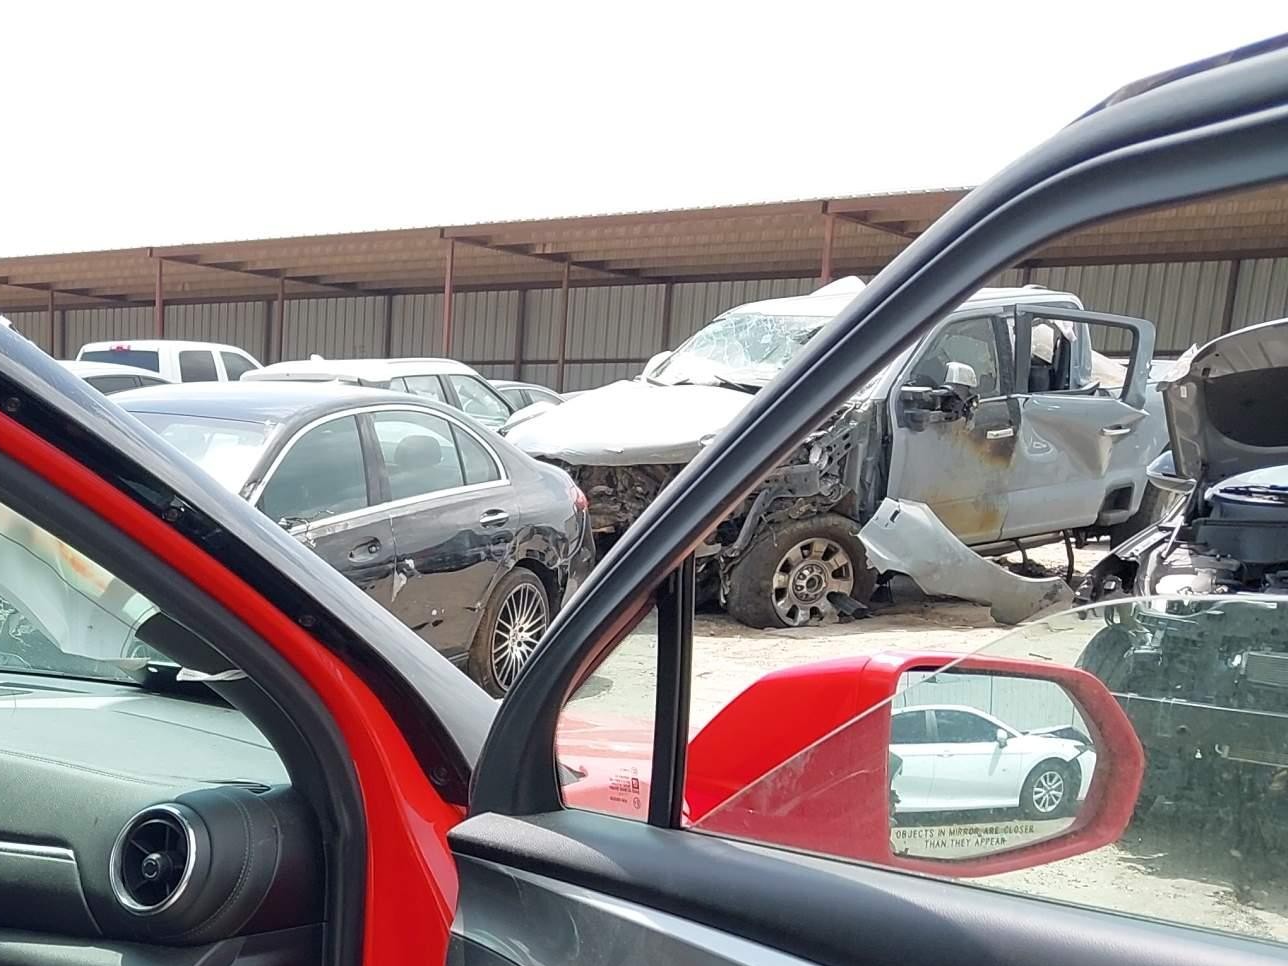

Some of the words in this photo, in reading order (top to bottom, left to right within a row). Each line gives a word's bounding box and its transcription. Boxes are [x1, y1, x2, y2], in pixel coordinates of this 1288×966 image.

[896, 829, 934, 840] OBJECTS
[937, 829, 946, 837] IN
[948, 827, 979, 837] MIRROR
[983, 825, 999, 835] ARE
[1003, 825, 1035, 834] CLOSER
[925, 839, 947, 849] THAN
[951, 838, 970, 848] THEY
[974, 837, 1007, 847] APPEAR
